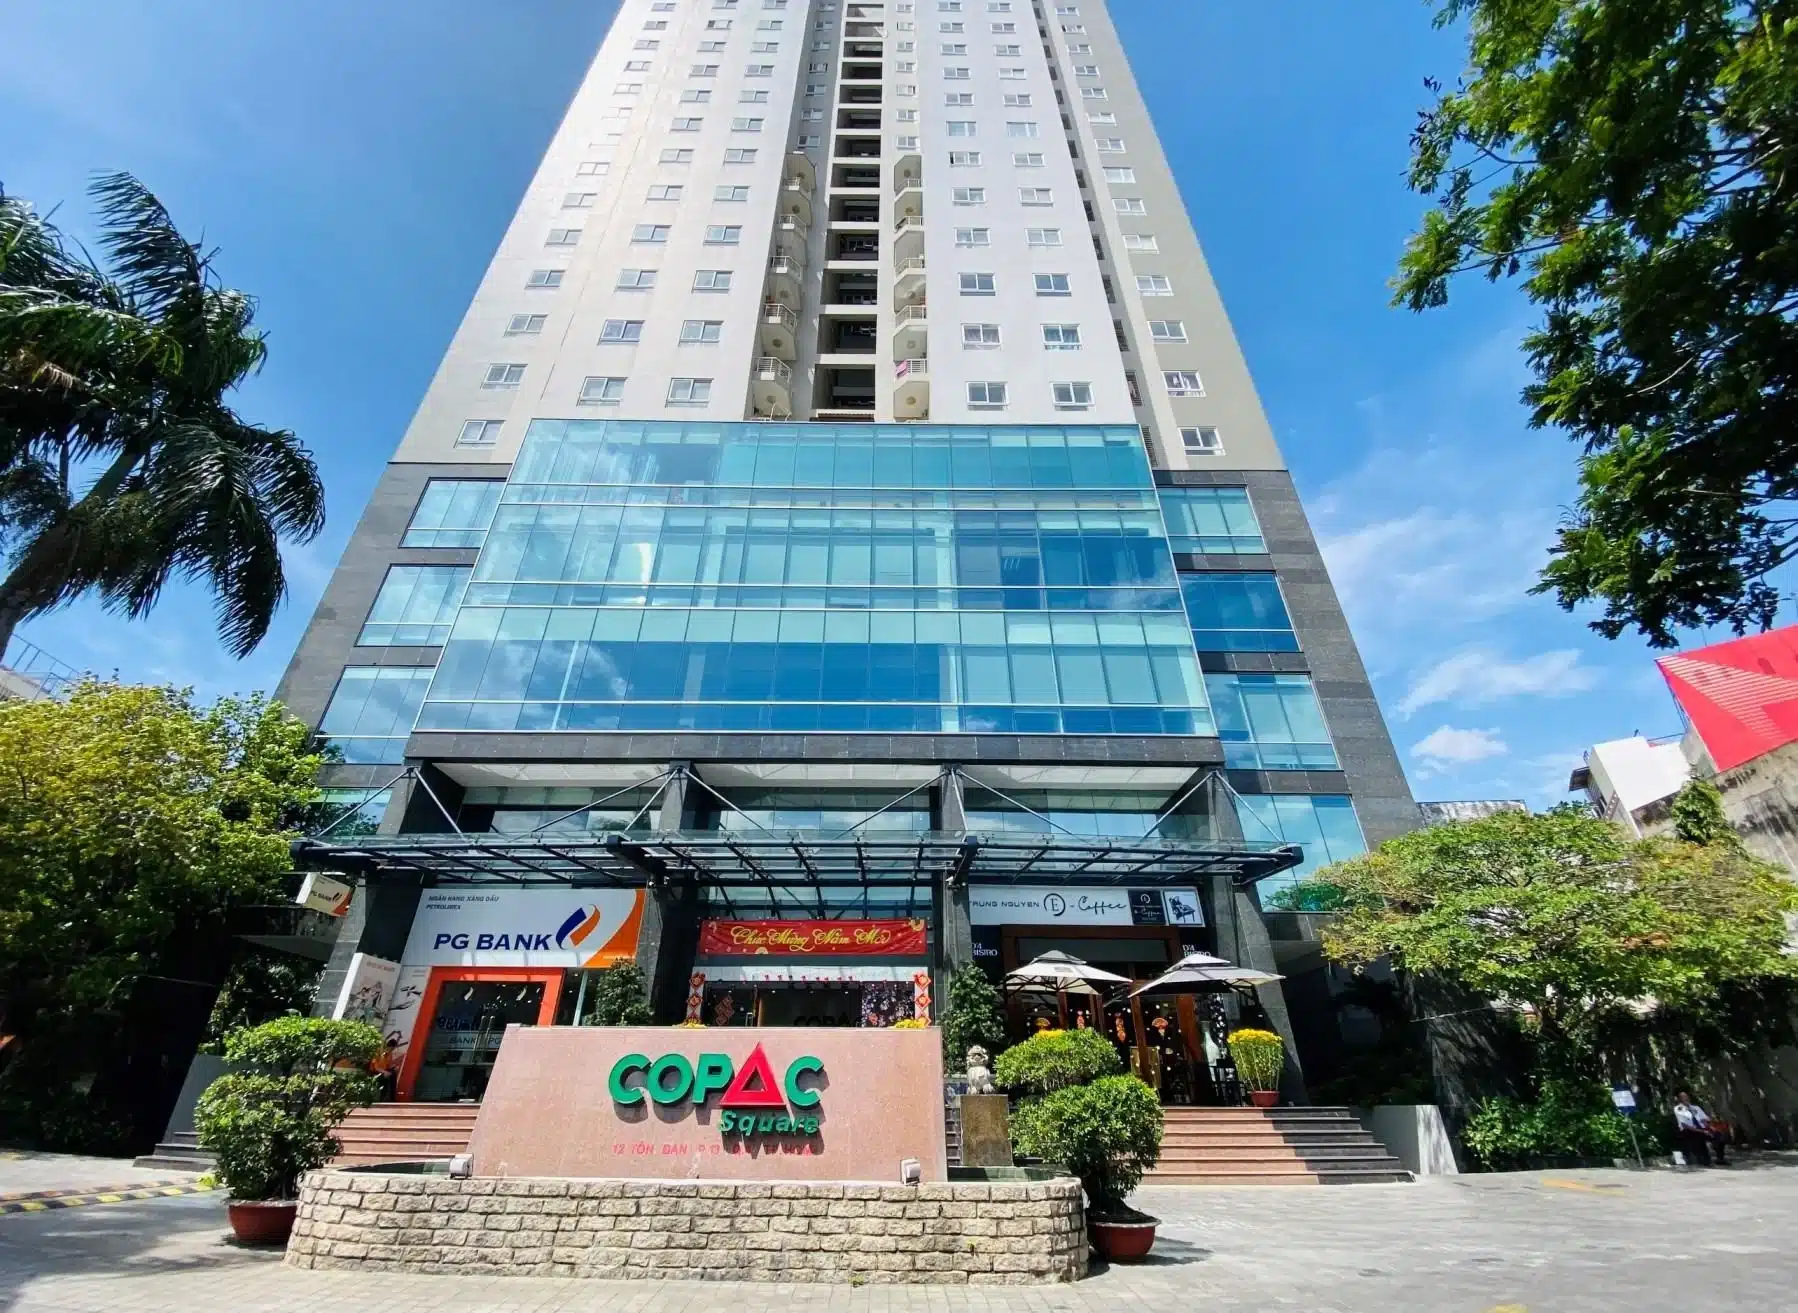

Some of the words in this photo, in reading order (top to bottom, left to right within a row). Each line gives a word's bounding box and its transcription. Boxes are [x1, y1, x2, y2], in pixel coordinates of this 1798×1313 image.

[1077, 895, 1127, 915] Coffee
[433, 933, 470, 950] PG
[476, 933, 553, 951] BANK
[609, 1041, 824, 1107] COPAC
[718, 1110, 819, 1137] Square
